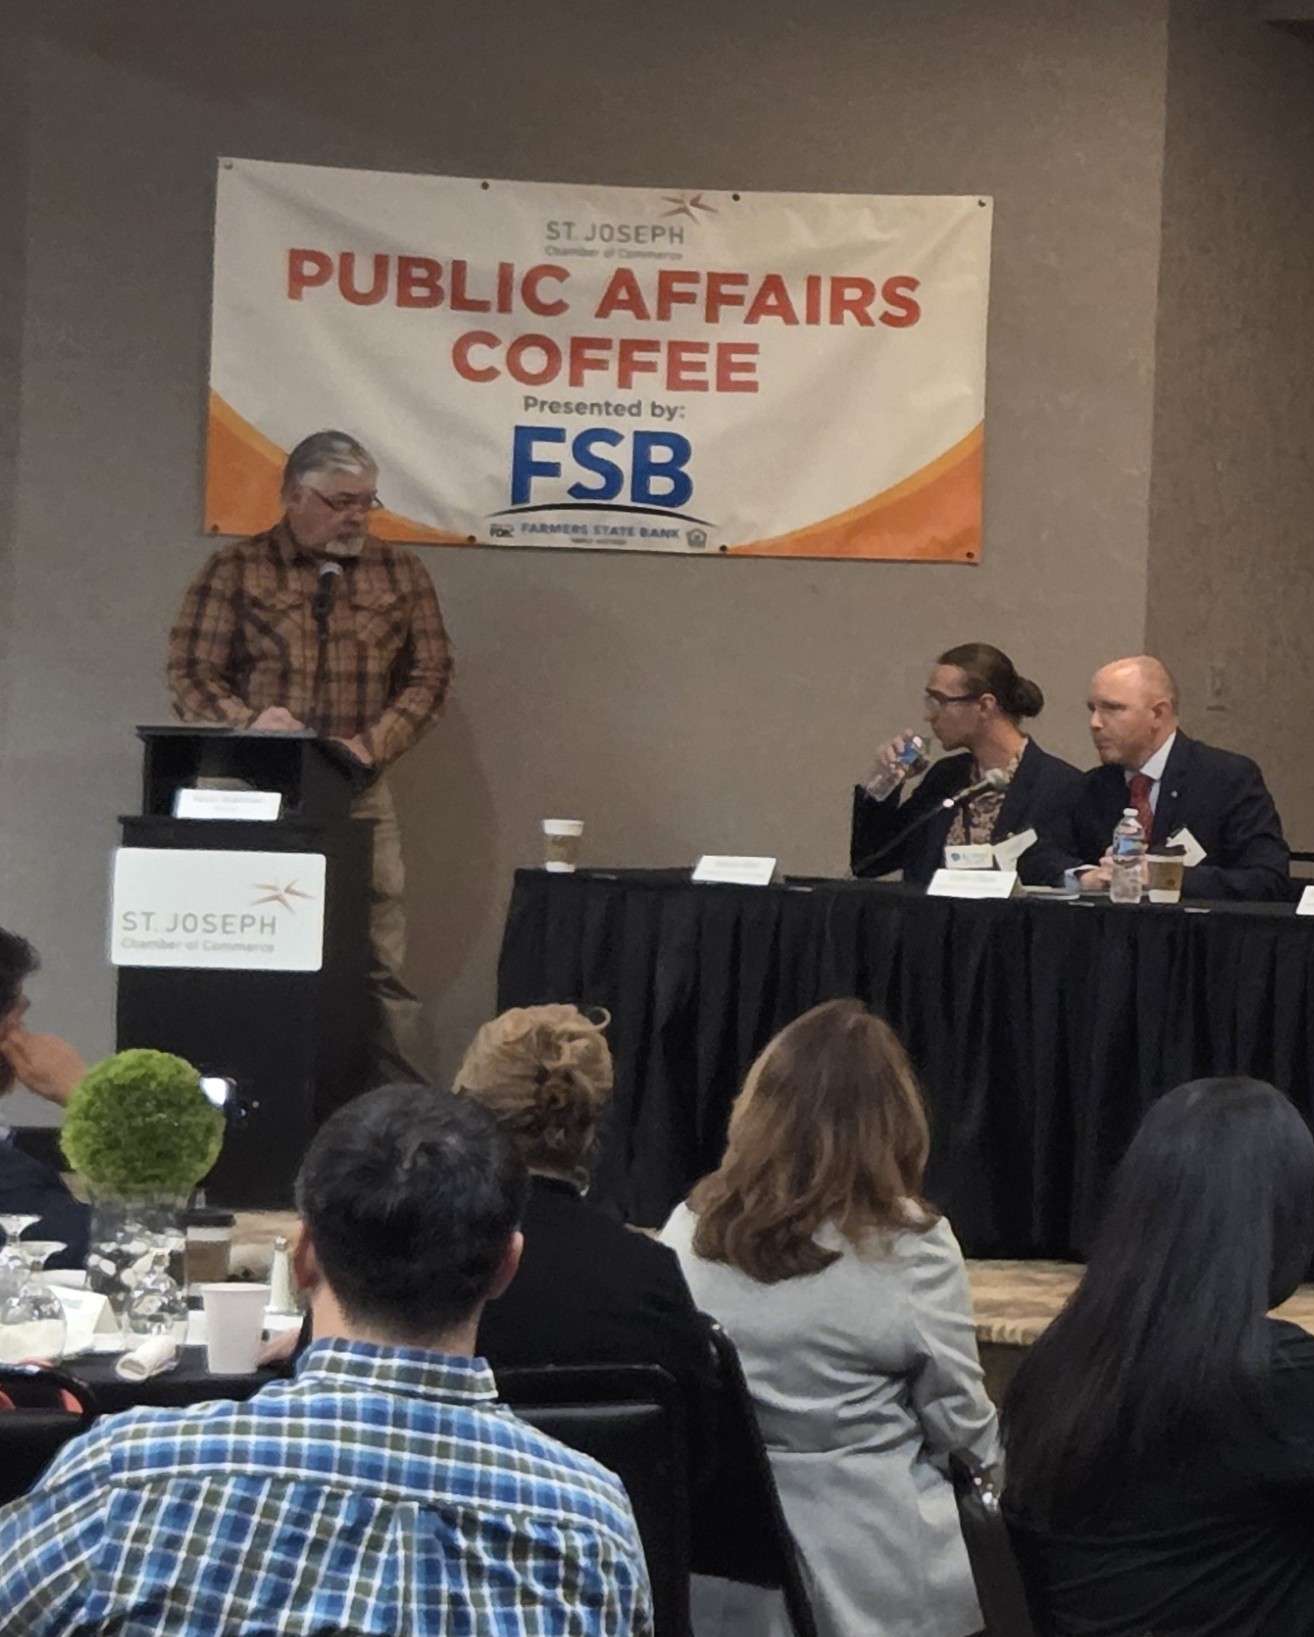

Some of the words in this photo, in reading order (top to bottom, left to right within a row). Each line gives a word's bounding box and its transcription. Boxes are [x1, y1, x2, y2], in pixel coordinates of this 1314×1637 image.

[584, 222, 684, 245] JOSEPH
[288, 248, 571, 317] PUBLIC
[594, 267, 921, 328] AFFAIRS
[452, 330, 760, 393] COFFEE
[523, 395, 642, 417] Presented
[650, 401, 686, 421] by:
[511, 425, 694, 508] FSB
[520, 522, 588, 536] FARMERS
[593, 524, 636, 538] STATE
[639, 527, 680, 540] BANK
[165, 911, 277, 935] JOSEPH
[120, 938, 180, 951] Chamber
[185, 940, 198, 951] of
[202, 940, 275, 954] Commerce
